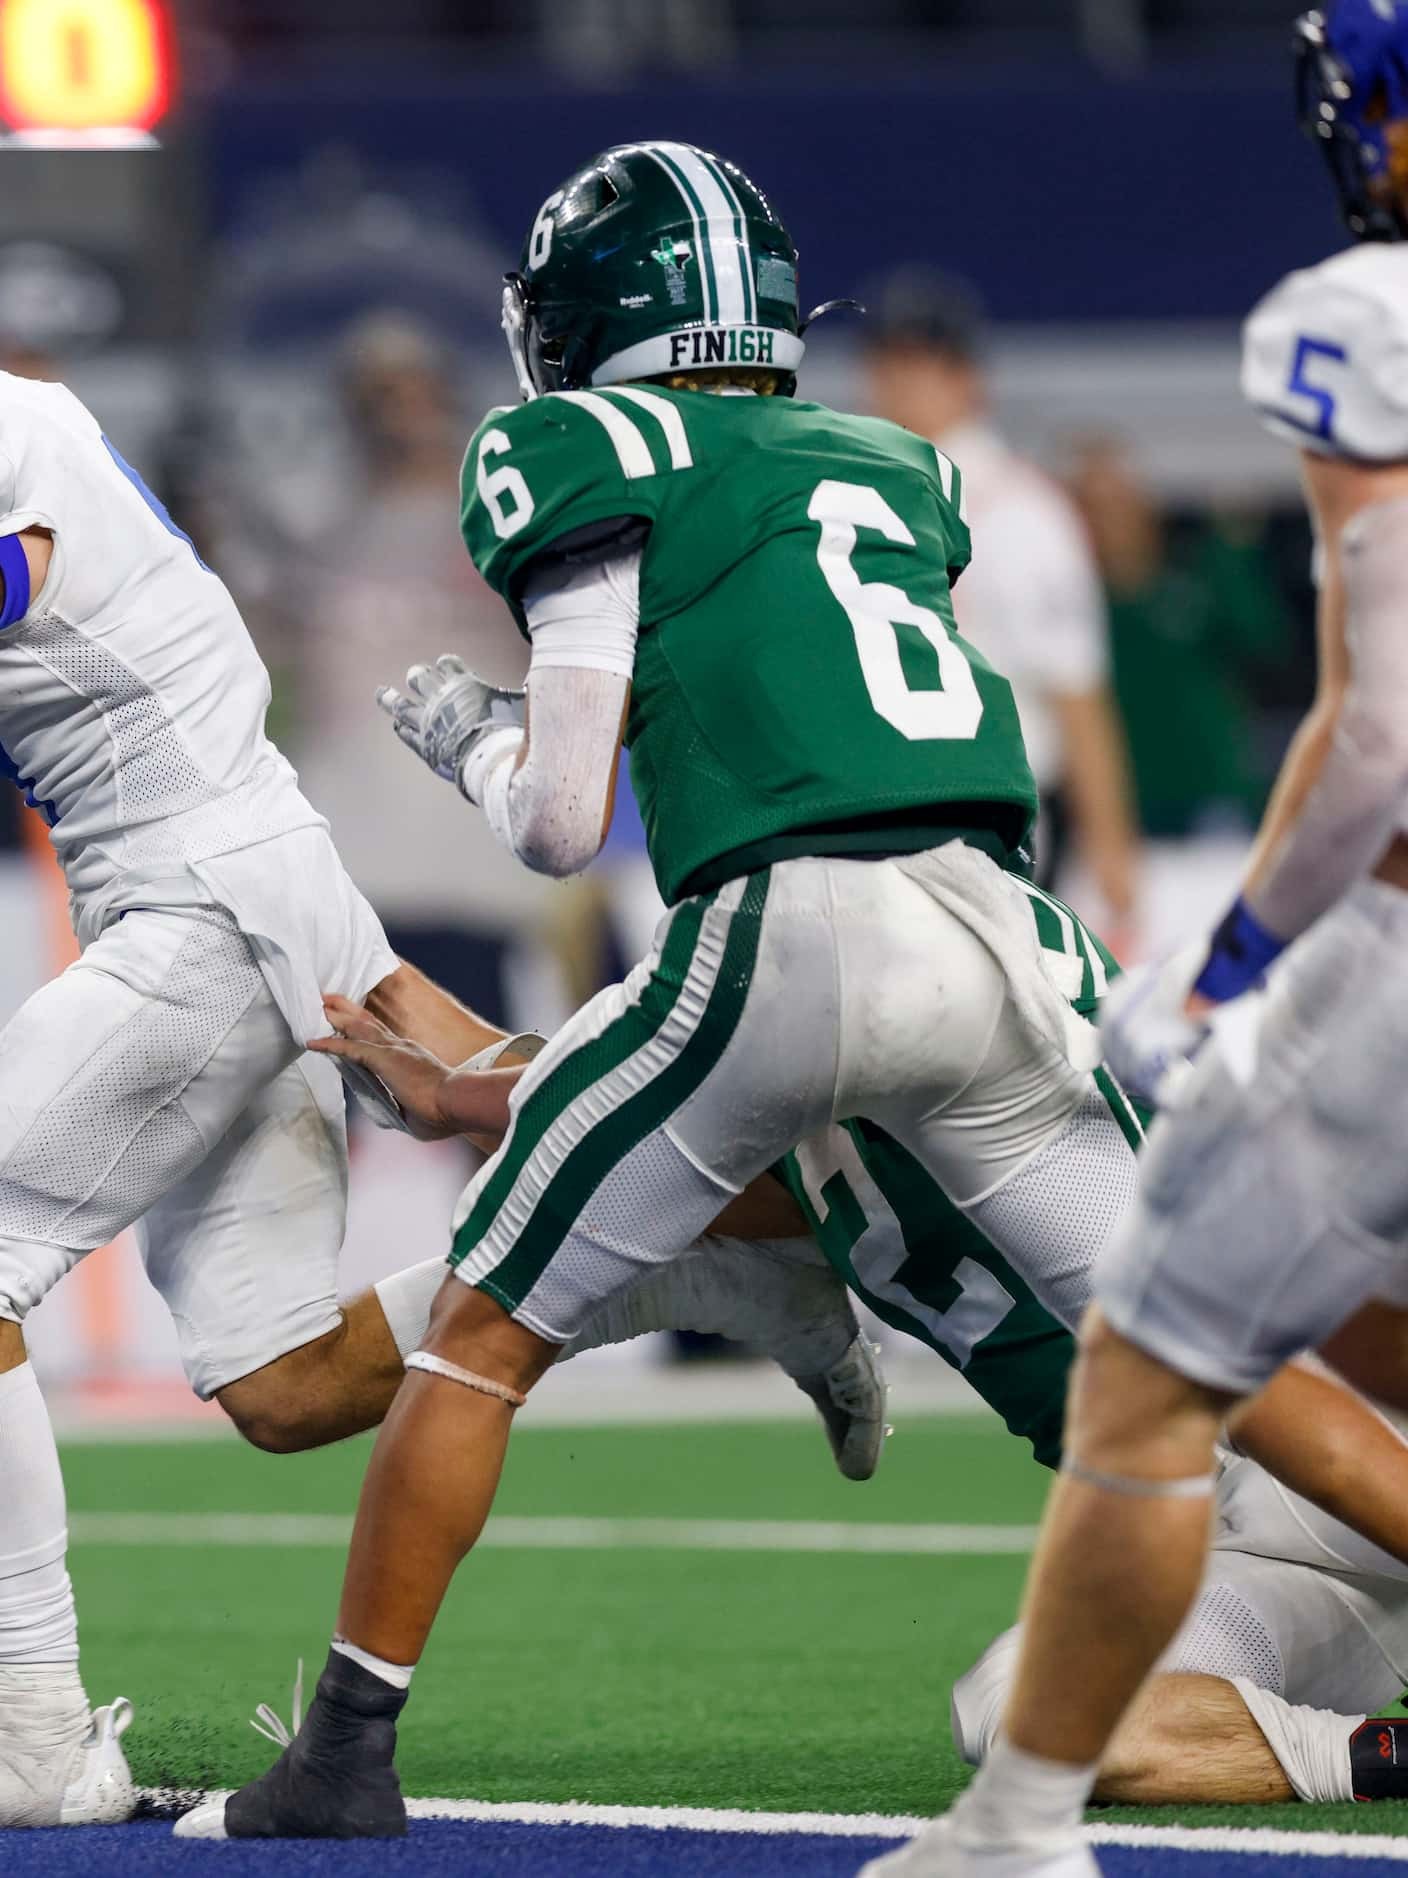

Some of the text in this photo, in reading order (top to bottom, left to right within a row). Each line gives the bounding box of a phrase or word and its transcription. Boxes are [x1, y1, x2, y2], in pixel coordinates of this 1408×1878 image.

[527, 190, 565, 271] 6
[669, 329, 774, 367] FIN16H
[1286, 335, 1347, 441] 5
[476, 428, 535, 539] 6
[807, 479, 984, 740] 6
